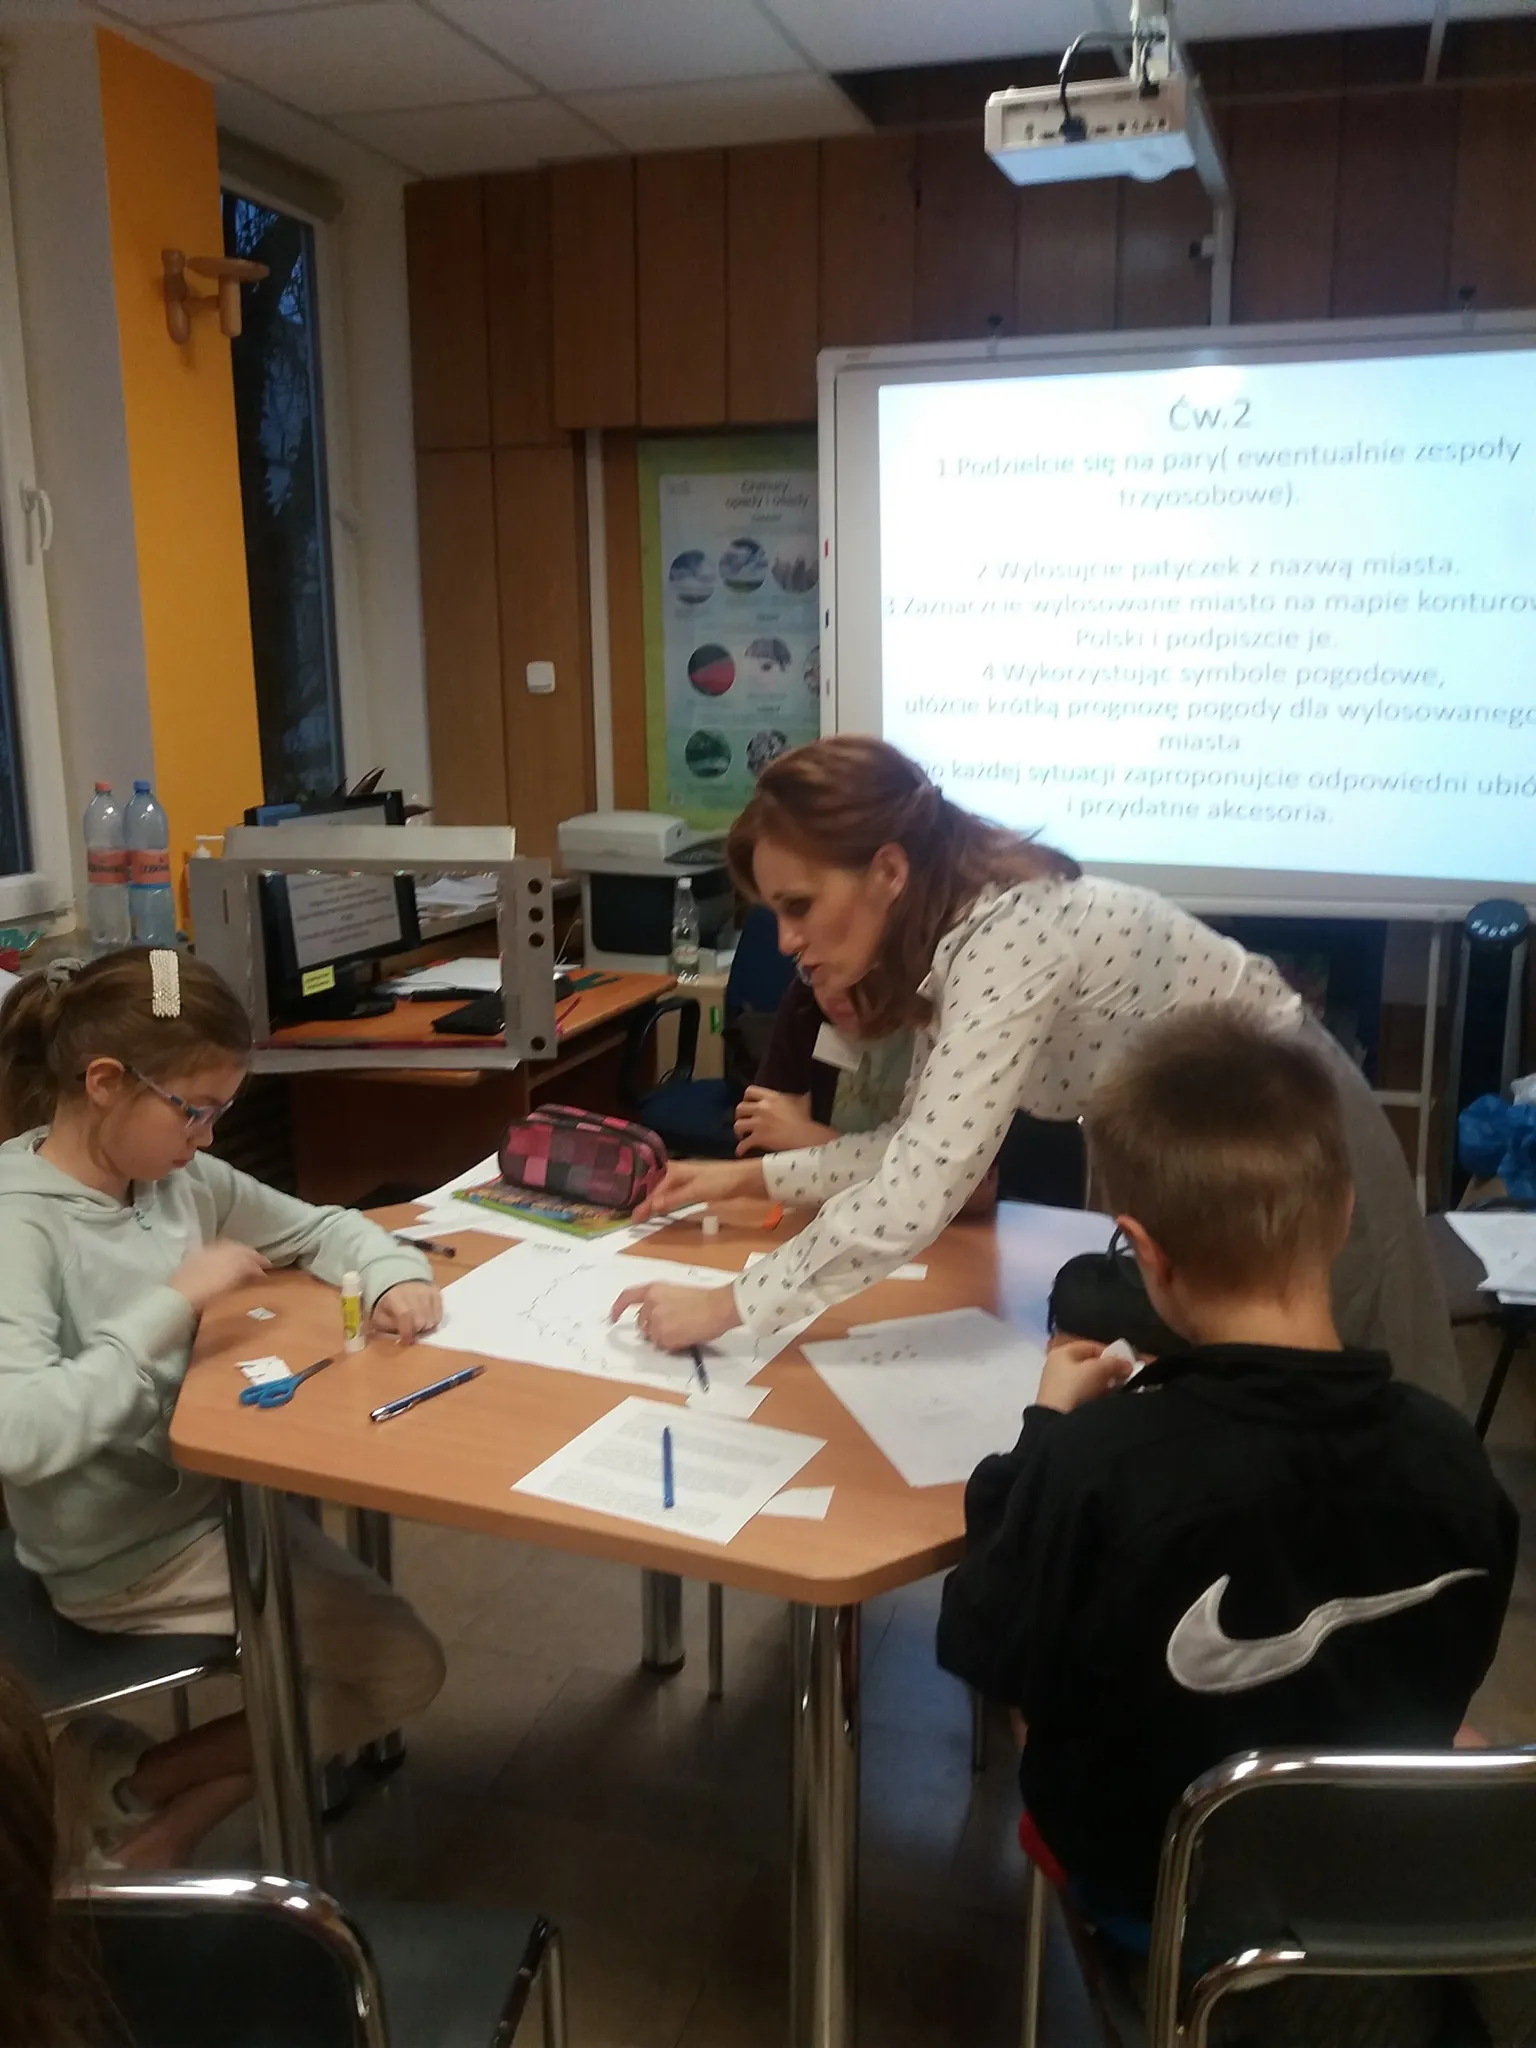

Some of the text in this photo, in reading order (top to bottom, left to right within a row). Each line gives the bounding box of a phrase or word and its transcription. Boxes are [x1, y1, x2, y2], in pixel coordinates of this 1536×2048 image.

[1169, 394, 1252, 431] Ćw.2
[957, 454, 1075, 477] Podzielcie
[1083, 451, 1116, 477] się
[1124, 453, 1154, 472] na
[1238, 439, 1405, 467] ewentualnie
[1415, 435, 1522, 465] zespoły
[1132, 555, 1240, 582] patyczek
[1249, 559, 1260, 577] z
[1269, 557, 1353, 581] nazwą
[1032, 593, 1181, 617] wylosowane
[1190, 591, 1276, 613] miasto
[1284, 594, 1317, 612] na
[1325, 591, 1410, 617] mapie
[1418, 588, 1536, 612] konturo
[1075, 628, 1143, 648] Polski
[1166, 627, 1300, 652] podpiszcie
[1003, 661, 1172, 687] Wykorzystując
[1180, 661, 1287, 687] symbole
[1295, 661, 1446, 689] pogodowe,
[905, 695, 980, 716] ułóżcie
[987, 696, 1060, 719] krótką
[1067, 699, 1180, 722] prognozę
[1188, 698, 1281, 723] pogody
[1290, 697, 1329, 720] dla
[1158, 733, 1241, 752] miasta
[952, 760, 1021, 782] każdej
[1028, 761, 1115, 786] sytuacji
[1124, 764, 1301, 793] zaproponujcie
[1308, 768, 1468, 795] odpowiedni
[1080, 797, 1199, 821] przydatne
